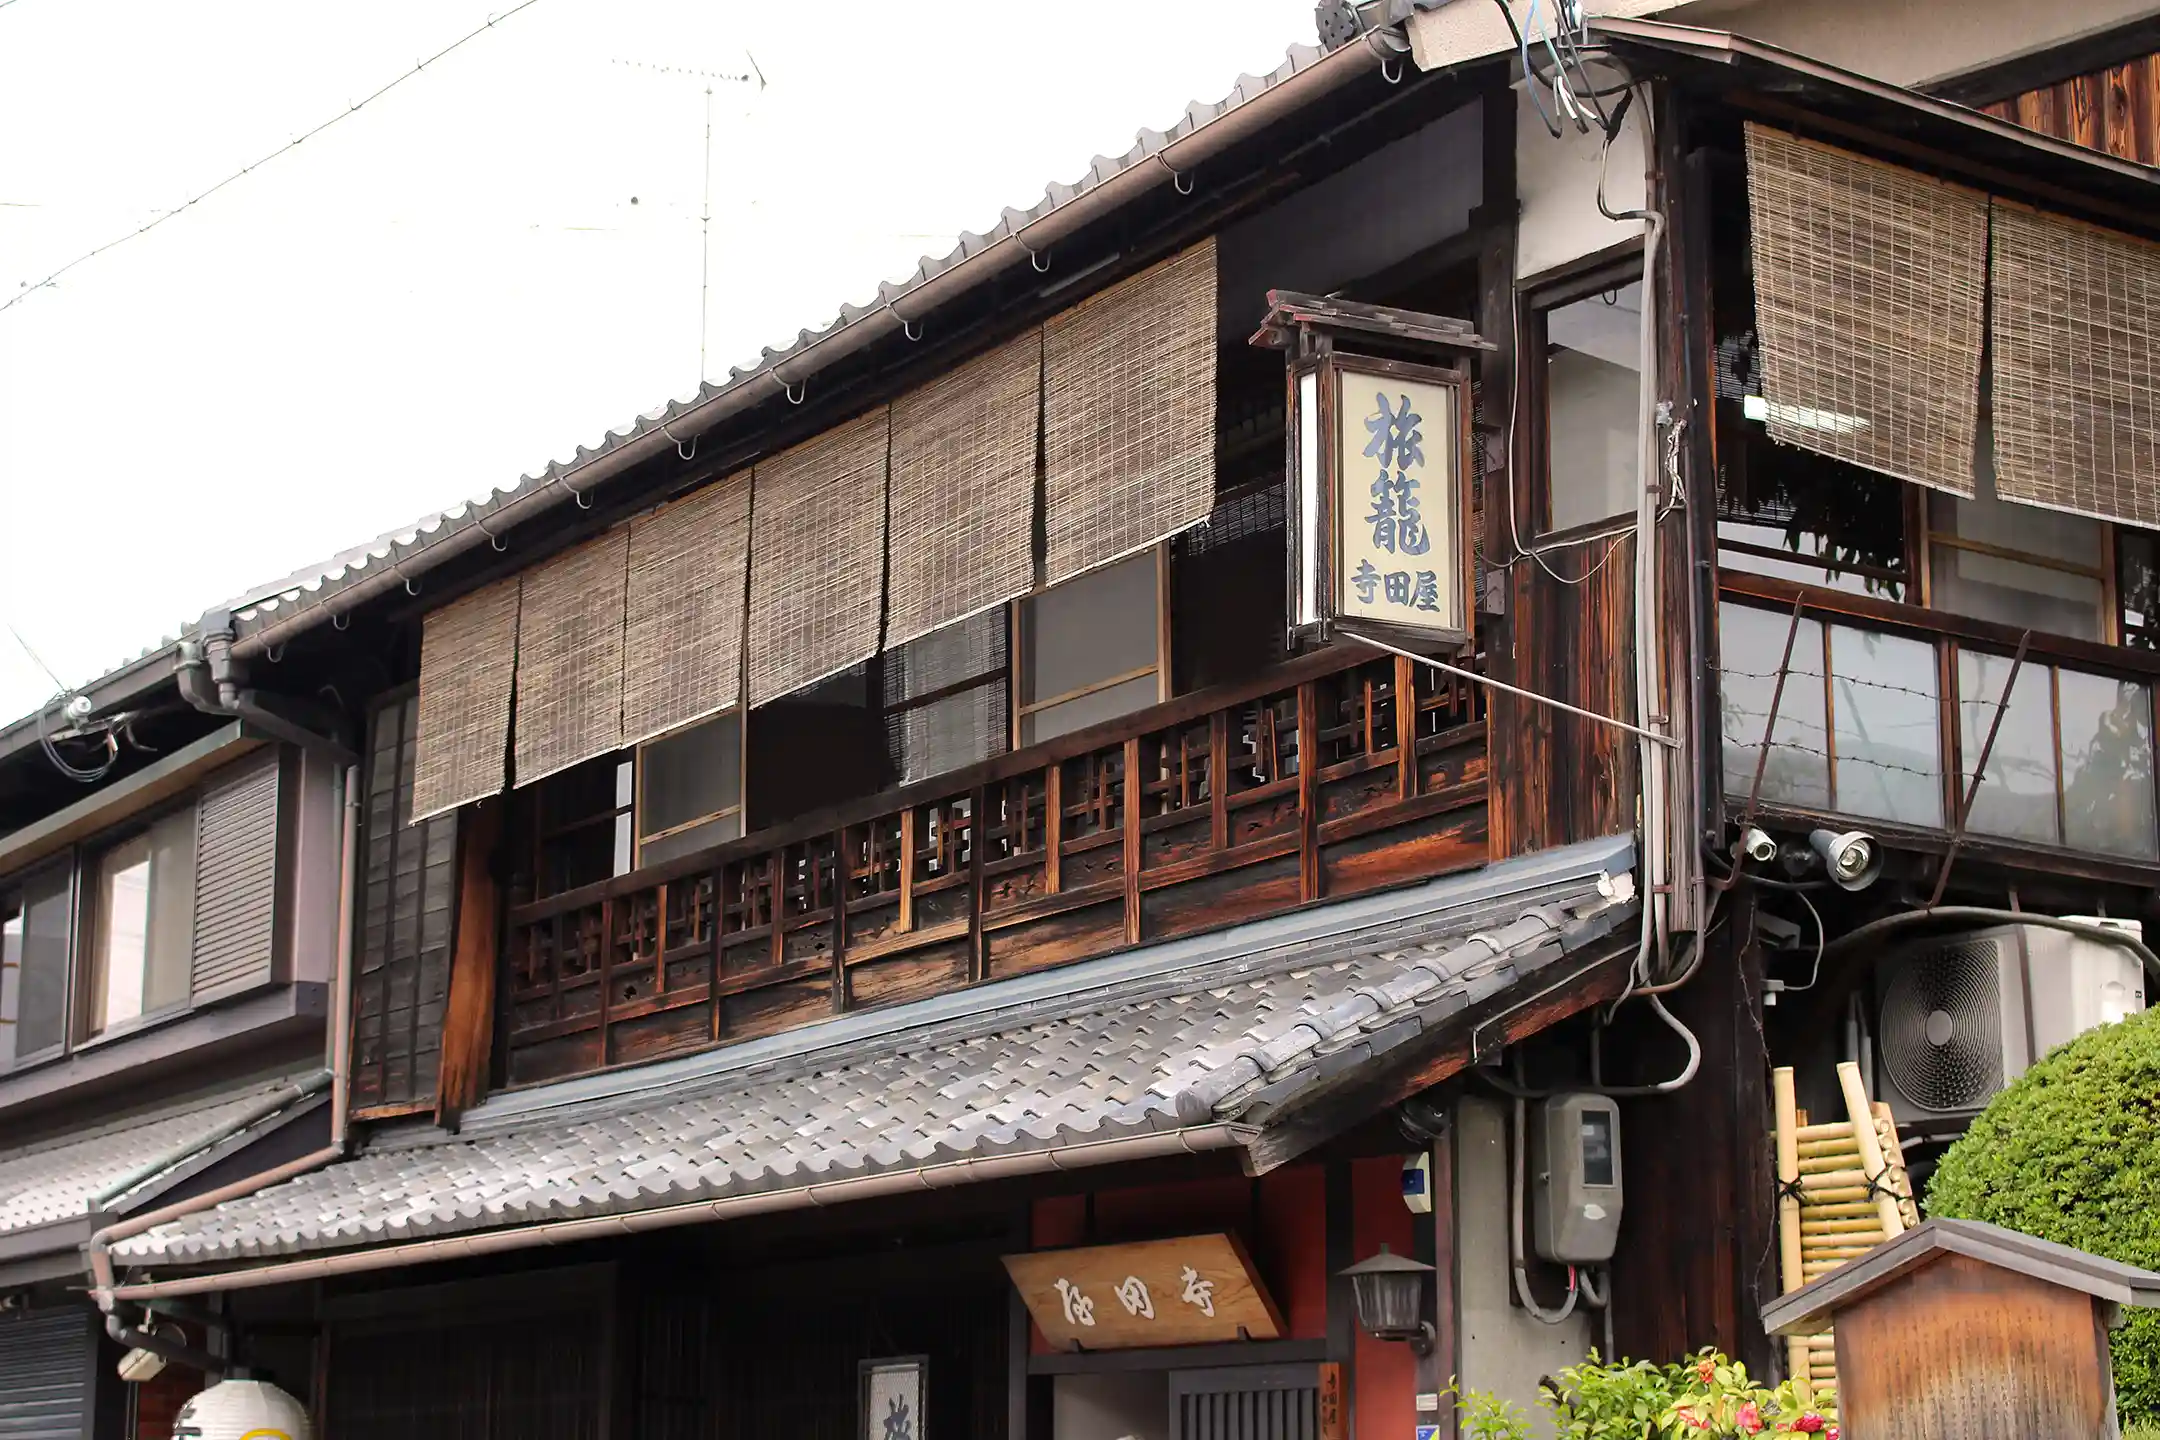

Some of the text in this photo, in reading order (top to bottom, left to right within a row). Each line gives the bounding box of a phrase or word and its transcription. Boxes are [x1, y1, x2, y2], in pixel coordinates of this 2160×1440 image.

[1363, 391, 1431, 556] 旅籠
[1350, 558, 1441, 613] 寺田屋
